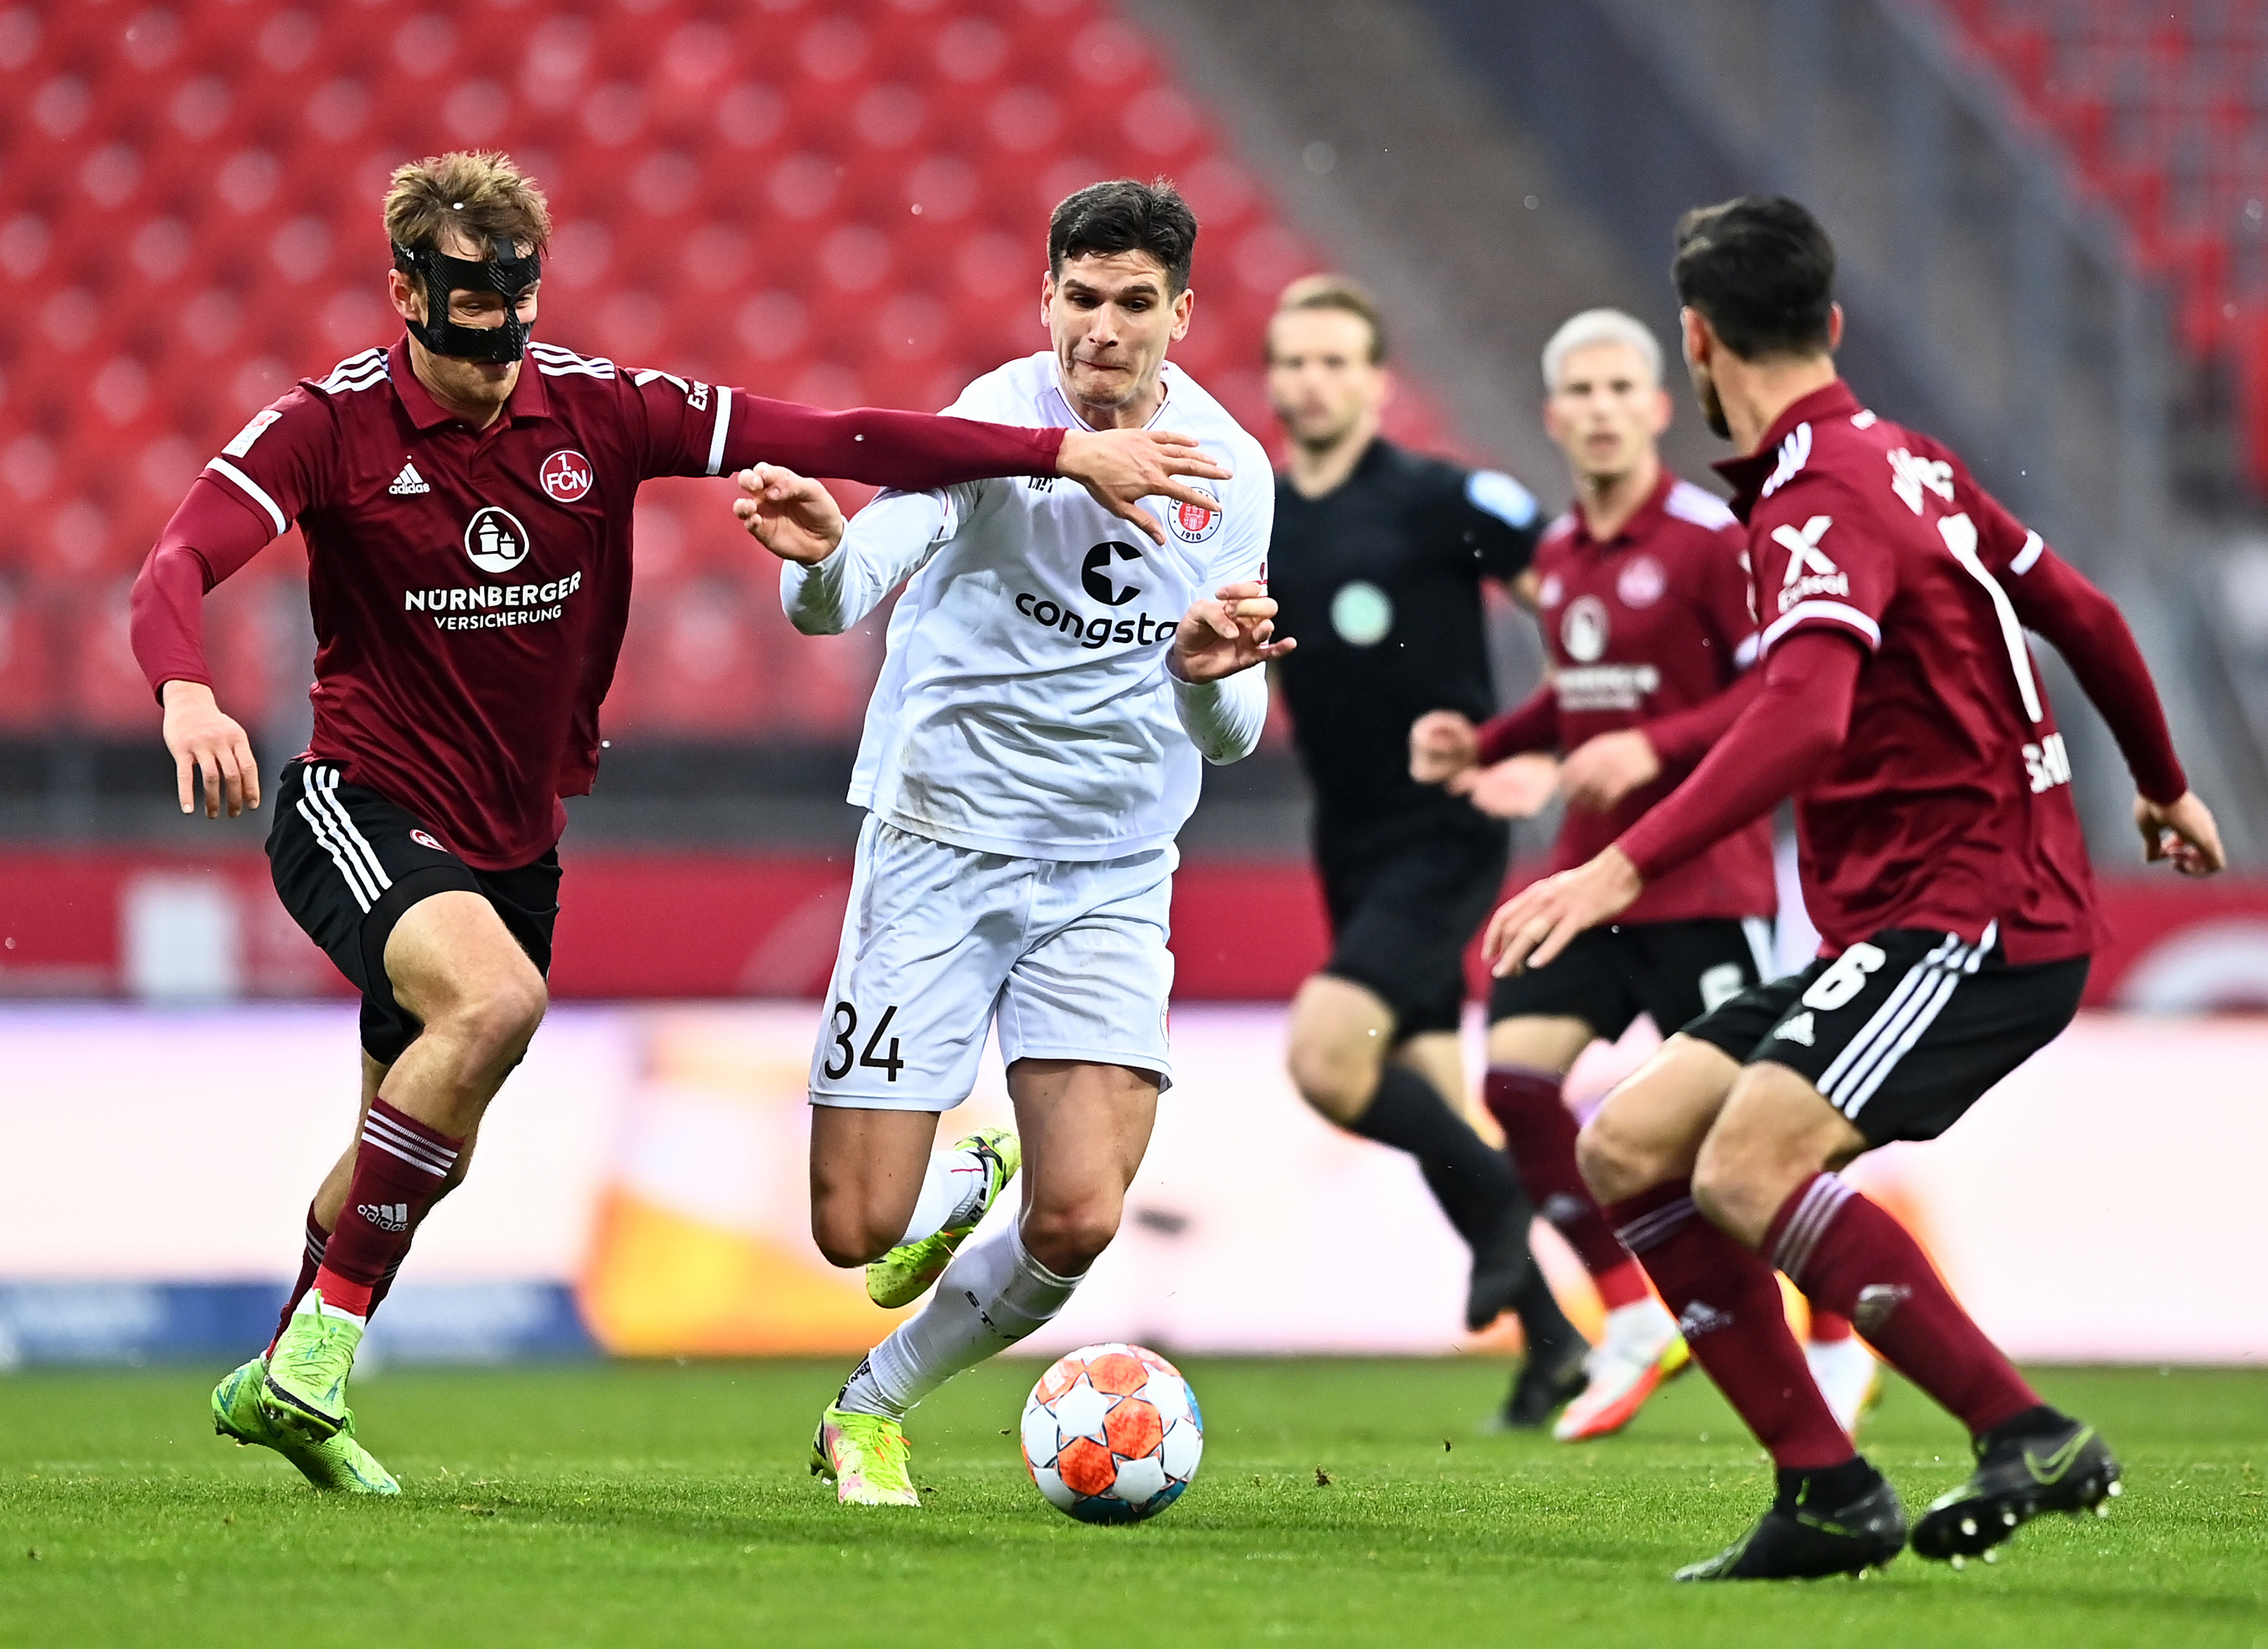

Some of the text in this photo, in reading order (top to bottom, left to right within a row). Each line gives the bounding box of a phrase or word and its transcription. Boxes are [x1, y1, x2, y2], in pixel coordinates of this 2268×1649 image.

[558, 453, 571, 471] 1.
[389, 483, 430, 494] adidas
[546, 469, 587, 492] FCN
[1181, 530, 1202, 540] 1910
[406, 571, 581, 611] NÜRNBERGER
[434, 605, 562, 630] VERSICHERUNG
[1015, 593, 1178, 649] congsta
[825, 1001, 904, 1082] 34
[357, 1204, 408, 1232] adidas
